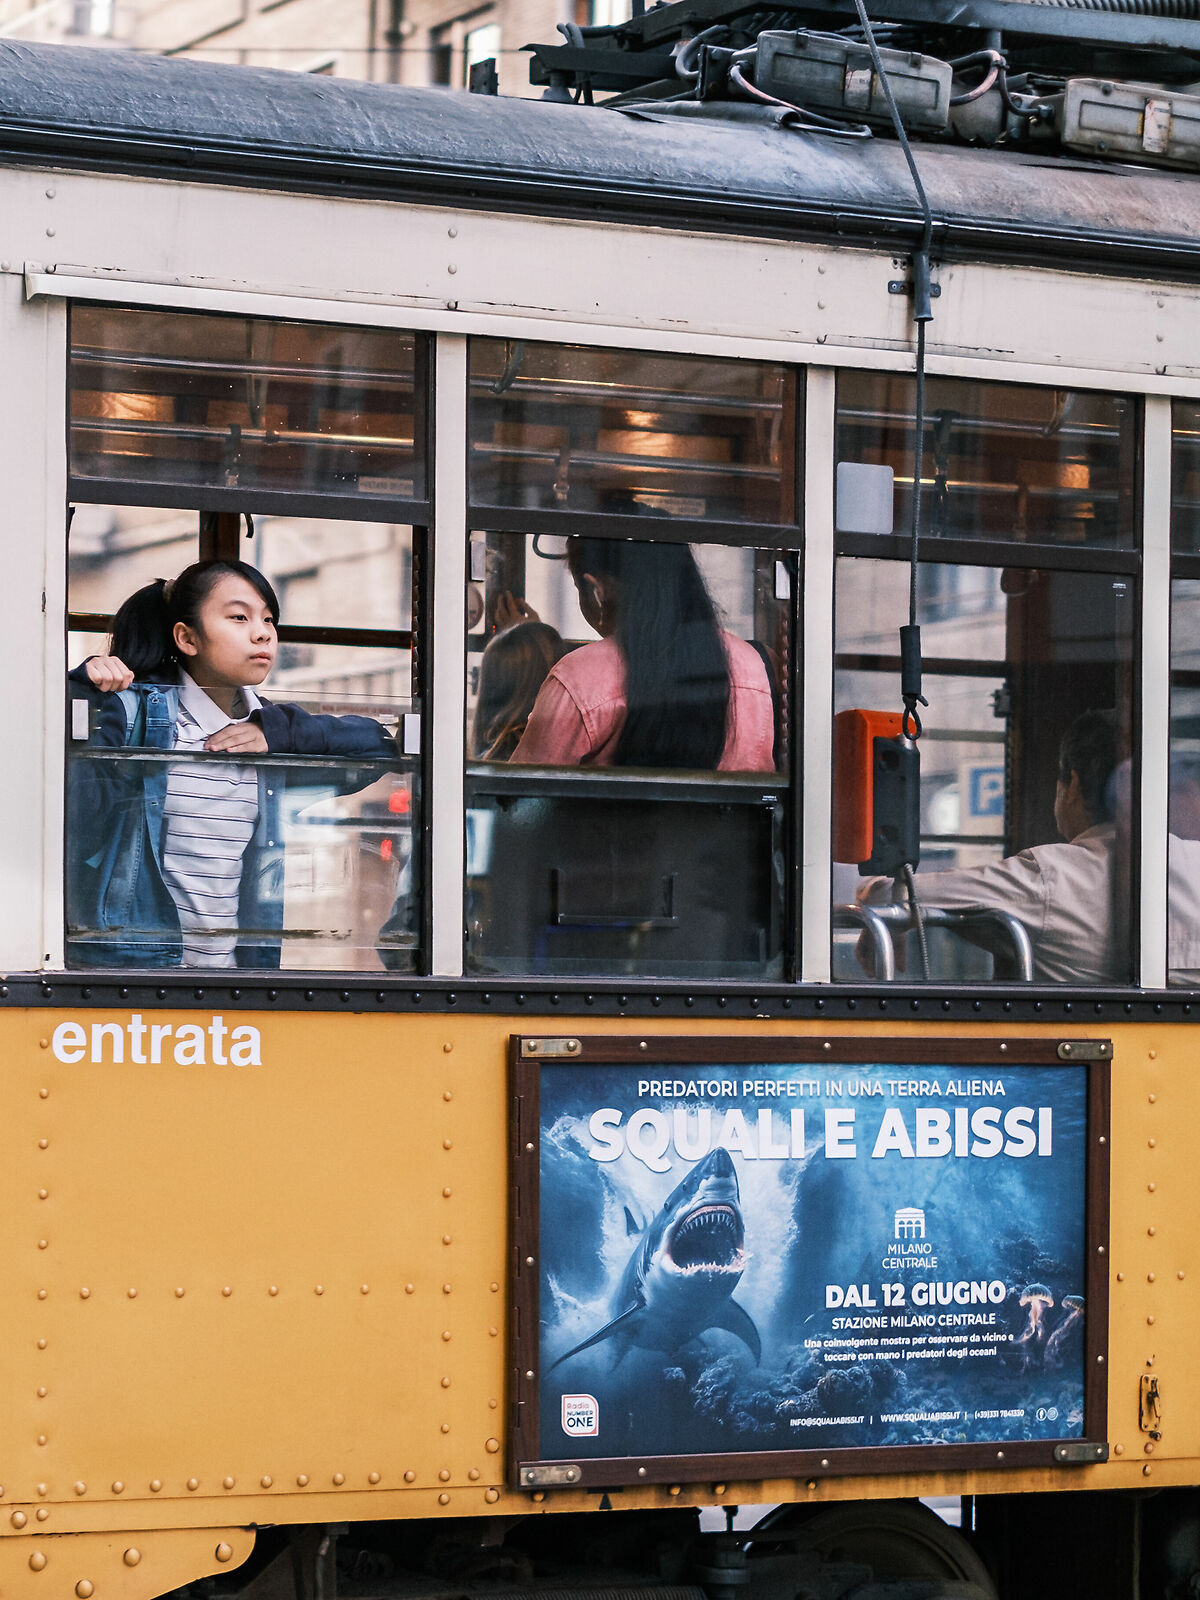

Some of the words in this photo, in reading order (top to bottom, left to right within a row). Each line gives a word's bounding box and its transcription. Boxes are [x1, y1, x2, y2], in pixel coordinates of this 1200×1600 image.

[979, 773, 1005, 810] P
[52, 1014, 262, 1067] entrata
[638, 1080, 737, 1097] PREDATORI
[743, 1080, 821, 1097] PERFETTI
[826, 1080, 842, 1096] IN
[848, 1080, 884, 1096] UNA
[888, 1080, 942, 1096] TERRA
[945, 1080, 1006, 1096] ALIENA
[588, 1108, 806, 1173] SQUALI
[824, 1108, 857, 1159] E
[871, 1106, 1053, 1158] ABISSI
[887, 1243, 932, 1255] MILANO
[882, 1257, 938, 1269] CENTRALE
[825, 1284, 876, 1309] DAL
[881, 1283, 906, 1307] 12
[911, 1280, 1007, 1306] GIUGNO
[831, 1316, 888, 1330] STAZIONE
[890, 1315, 936, 1328] MILANO
[938, 1313, 996, 1327] CENTRALE
[804, 1339, 822, 1348] Una
[823, 1338, 879, 1348] coinvolgente
[880, 1336, 910, 1346] mostra
[912, 1337, 927, 1346] per
[928, 1334, 968, 1344] osservare
[969, 1333, 980, 1343] da
[981, 1332, 1007, 1342] vicino
[1008, 1333, 1014, 1341] e
[824, 1352, 856, 1362] toccare
[857, 1353, 873, 1361] con
[875, 1351, 900, 1360] mano
[906, 1348, 945, 1360] predatori
[946, 1347, 968, 1358] degli
[969, 1346, 997, 1357] oceani
[567, 1402, 590, 1410] Radio
[567, 1416, 593, 1428] ONE
